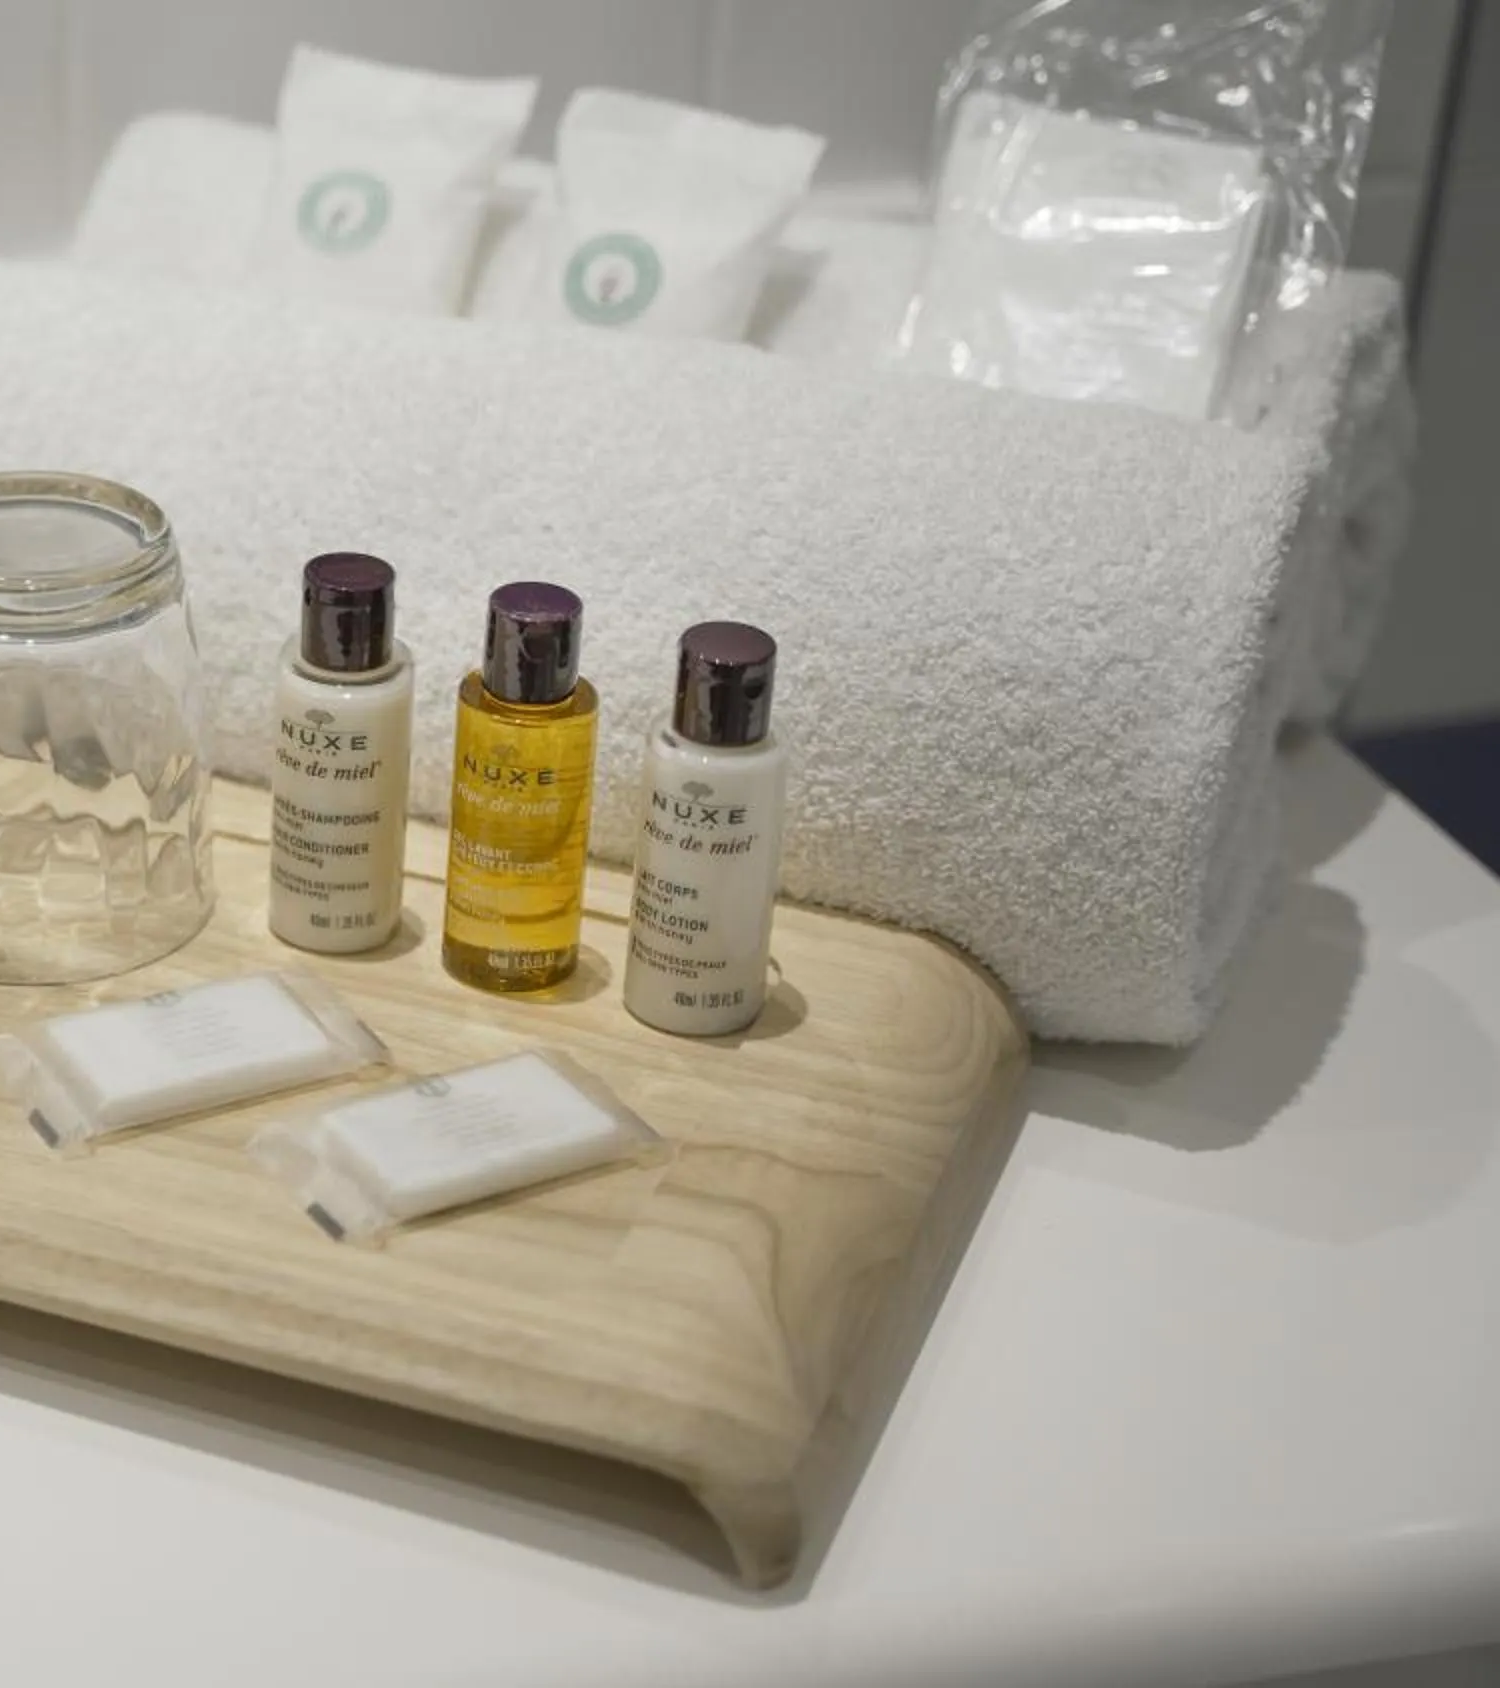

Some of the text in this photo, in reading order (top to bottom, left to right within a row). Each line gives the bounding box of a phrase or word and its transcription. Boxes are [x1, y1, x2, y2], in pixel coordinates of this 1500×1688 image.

[280, 718, 369, 752] NUXE
[305, 760, 329, 779] de
[463, 752, 557, 786] NUXE
[651, 790, 749, 826] NUXE
[679, 834, 704, 853] de
[657, 878, 700, 901] CORPS
[660, 913, 710, 933] LOTION
